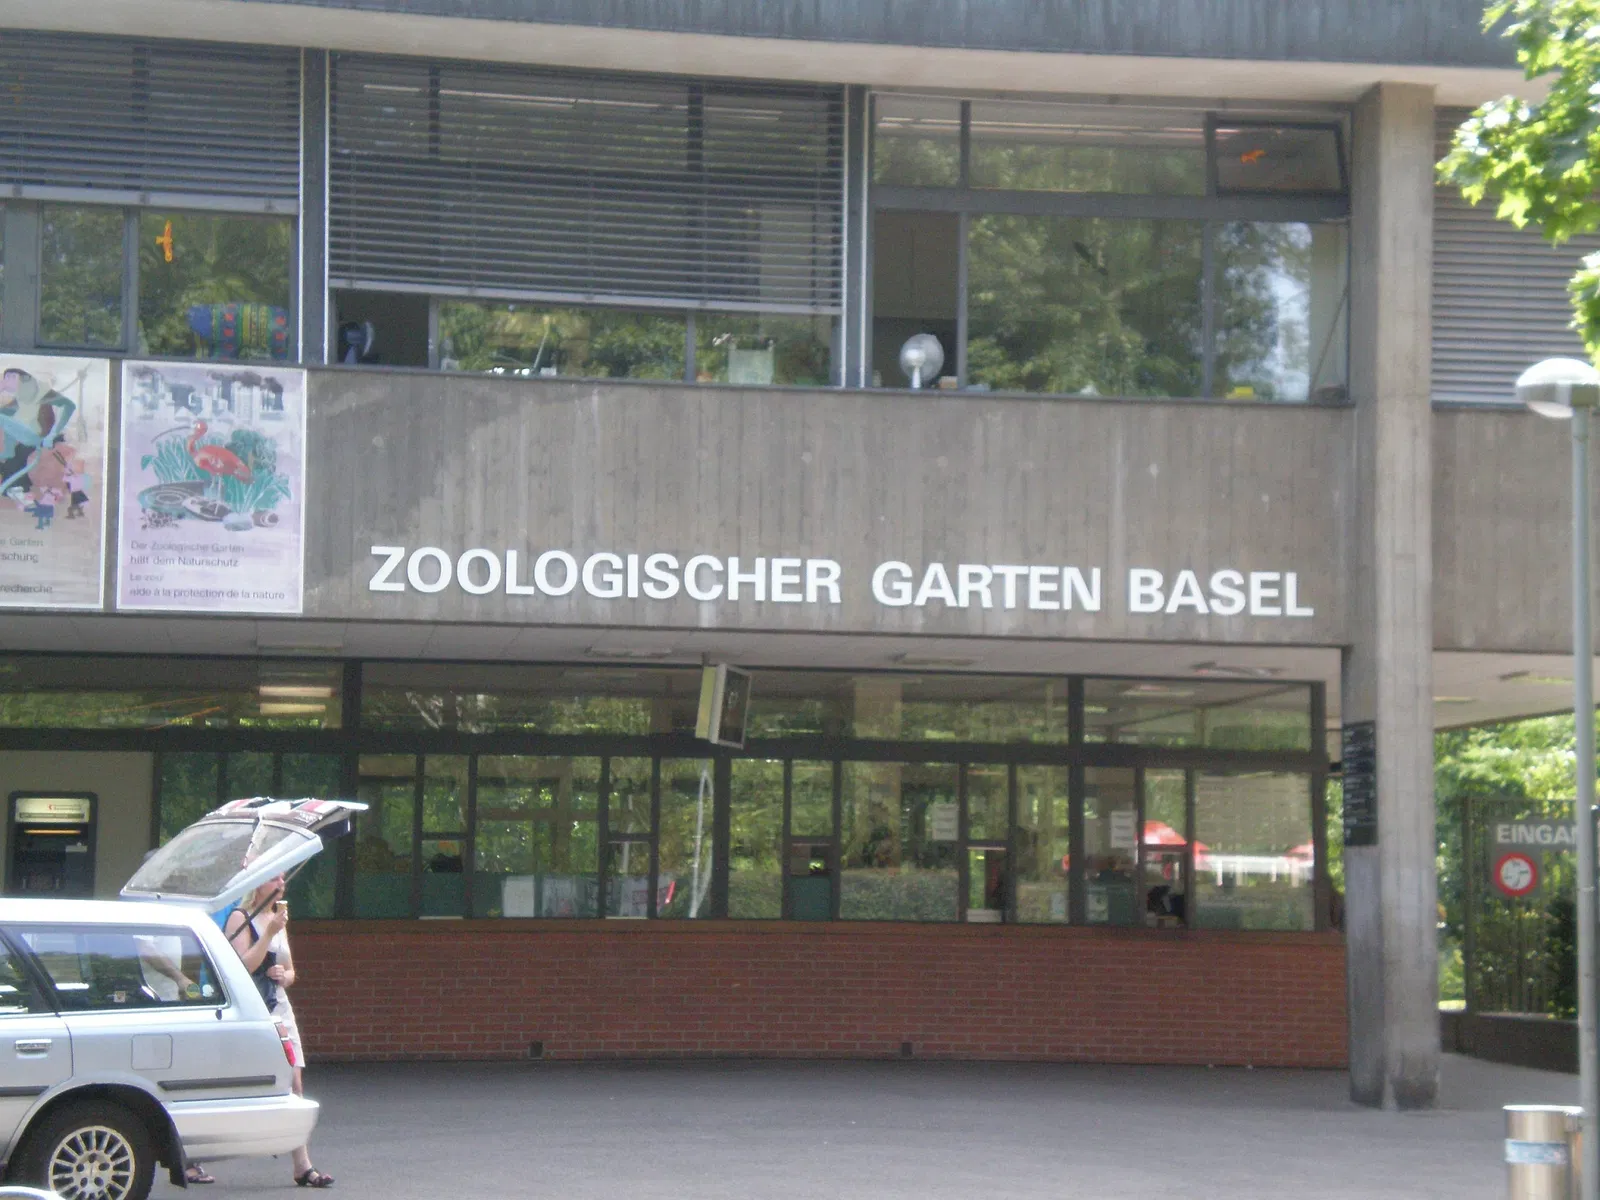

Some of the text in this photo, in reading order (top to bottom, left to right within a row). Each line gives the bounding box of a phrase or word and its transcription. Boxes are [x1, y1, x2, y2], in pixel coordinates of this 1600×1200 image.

[130, 540, 147, 550] Der
[211, 543, 245, 553] Garten
[153, 555, 175, 565] dem
[177, 556, 239, 568] Naturschutz
[369, 545, 1315, 617] ZOOLOGISCHER GARTEN BASEL
[173, 588, 225, 600] protection
[226, 589, 239, 598] de
[241, 589, 250, 599] la
[252, 590, 285, 600] nature
